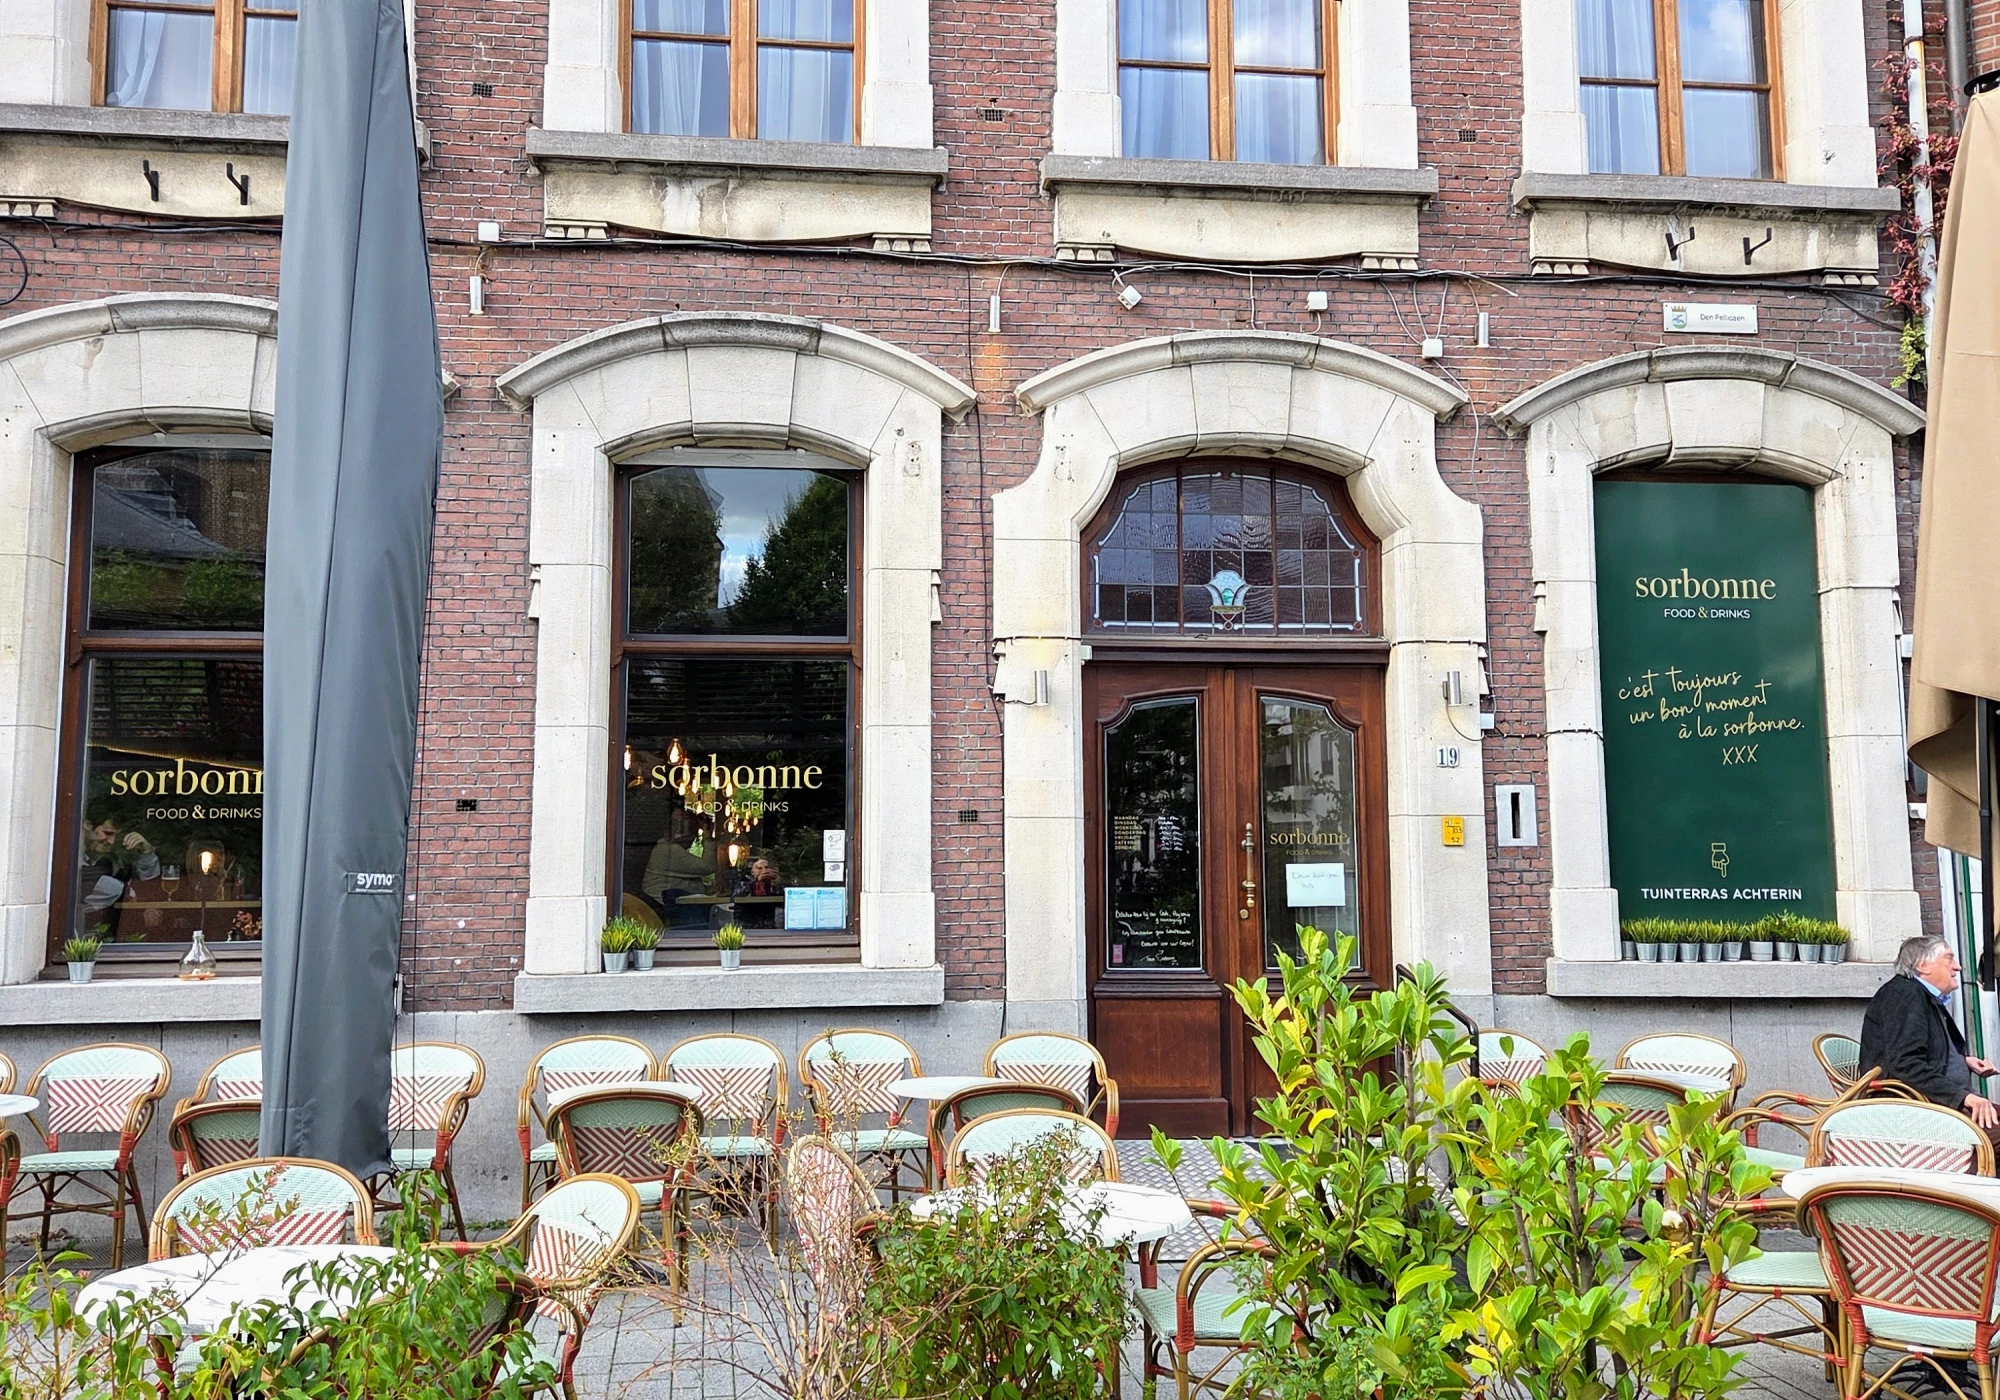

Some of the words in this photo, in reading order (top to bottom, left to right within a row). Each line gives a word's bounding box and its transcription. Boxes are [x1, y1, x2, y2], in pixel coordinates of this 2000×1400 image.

[1635, 567, 1777, 600] sorbonne
[1664, 608, 1696, 618] FOOD
[1698, 606, 1708, 619] &
[1710, 609, 1751, 619] DRINKS
[1618, 669, 1660, 700] c'est
[1664, 666, 1742, 707] toujours
[1629, 708, 1655, 725] un
[1660, 697, 1694, 722] bon
[1705, 678, 1773, 714] moment
[1678, 722, 1692, 739] à
[1697, 715, 1718, 738] la
[1723, 711, 1806, 737] sorbonne.
[1438, 747, 1458, 766] 19
[110, 757, 264, 796] sorbon
[651, 753, 823, 790] sorbonne
[146, 808, 189, 819] FOOD
[192, 804, 206, 819] &
[209, 807, 262, 819] DRINKS
[684, 801, 722, 813] FOOD
[741, 801, 789, 813] DRINKS
[1270, 827, 1349, 845] sorbonne
[357, 872, 393, 889] symo
[1641, 888, 1729, 900] TUINTERRAS
[1732, 888, 1802, 900] ACHTERIN
